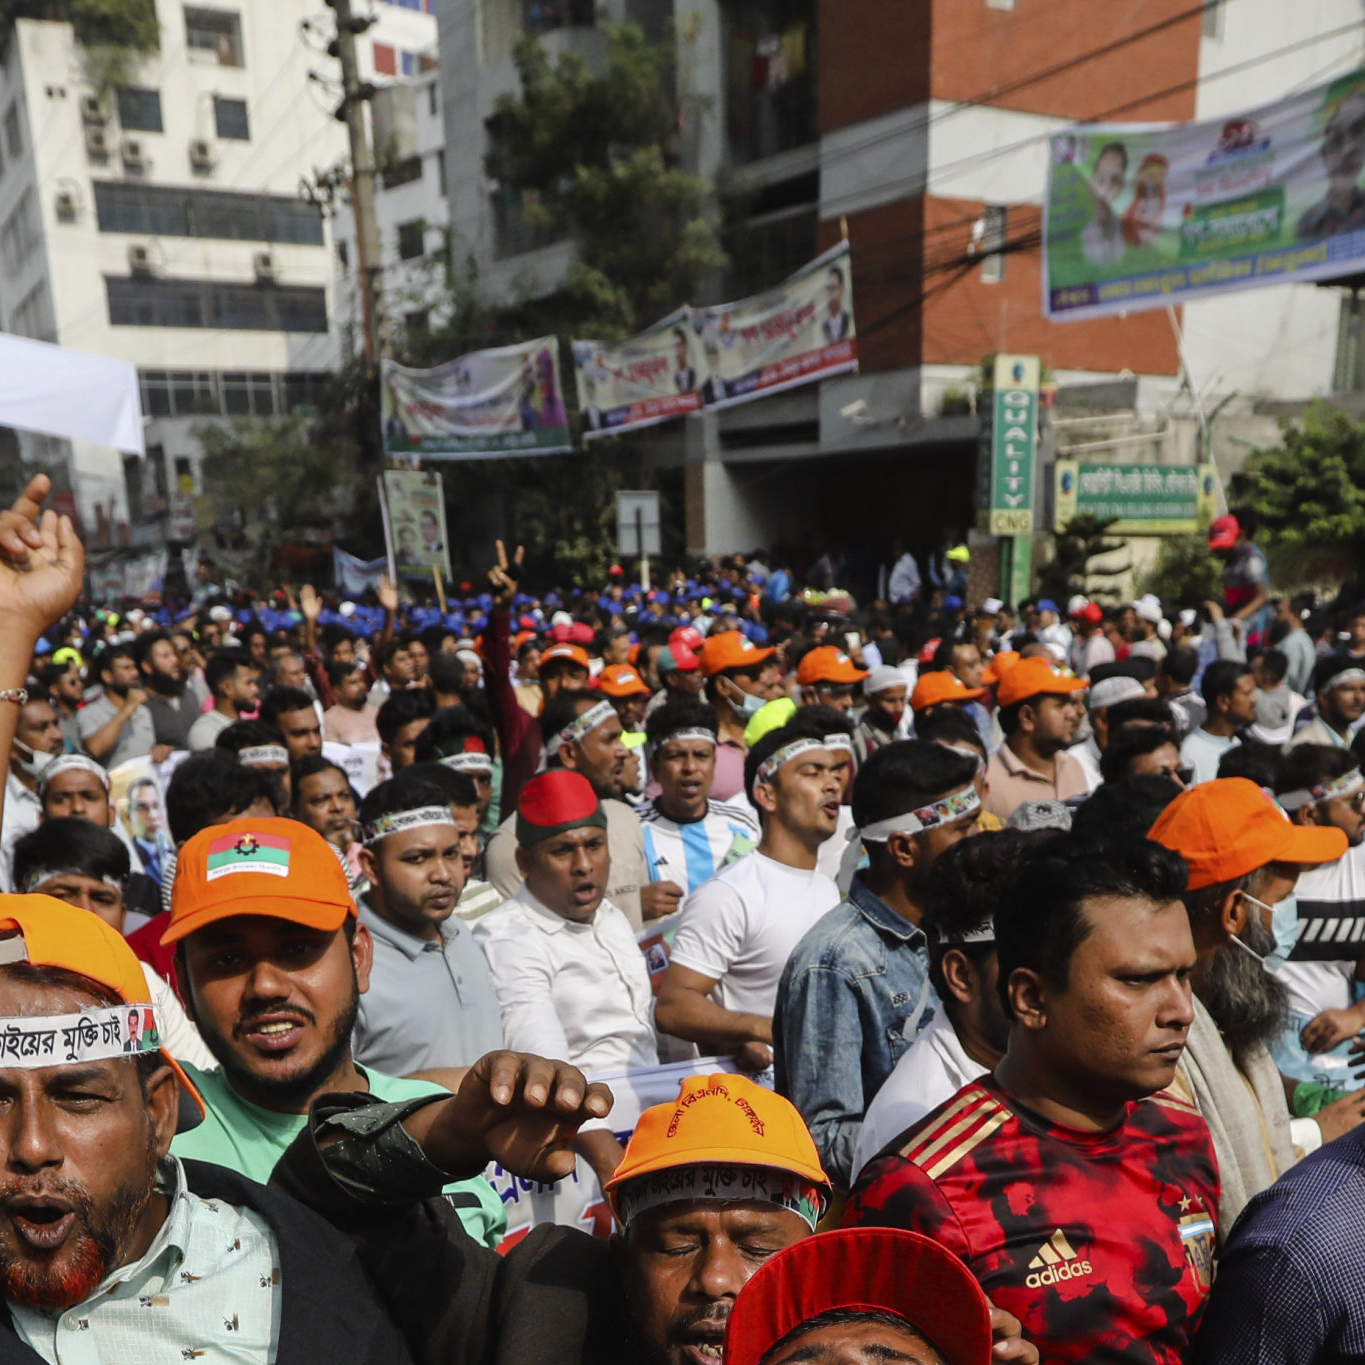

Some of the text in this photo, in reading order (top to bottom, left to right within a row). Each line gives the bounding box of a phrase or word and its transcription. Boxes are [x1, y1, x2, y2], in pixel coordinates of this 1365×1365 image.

[1003, 391, 1030, 509] QUALITY
[995, 513, 1030, 529] CNG
[62, 1016, 99, 1061] মুক্তি
[100, 1015, 121, 1047] চাই
[1025, 1259, 1093, 1289] adidas
